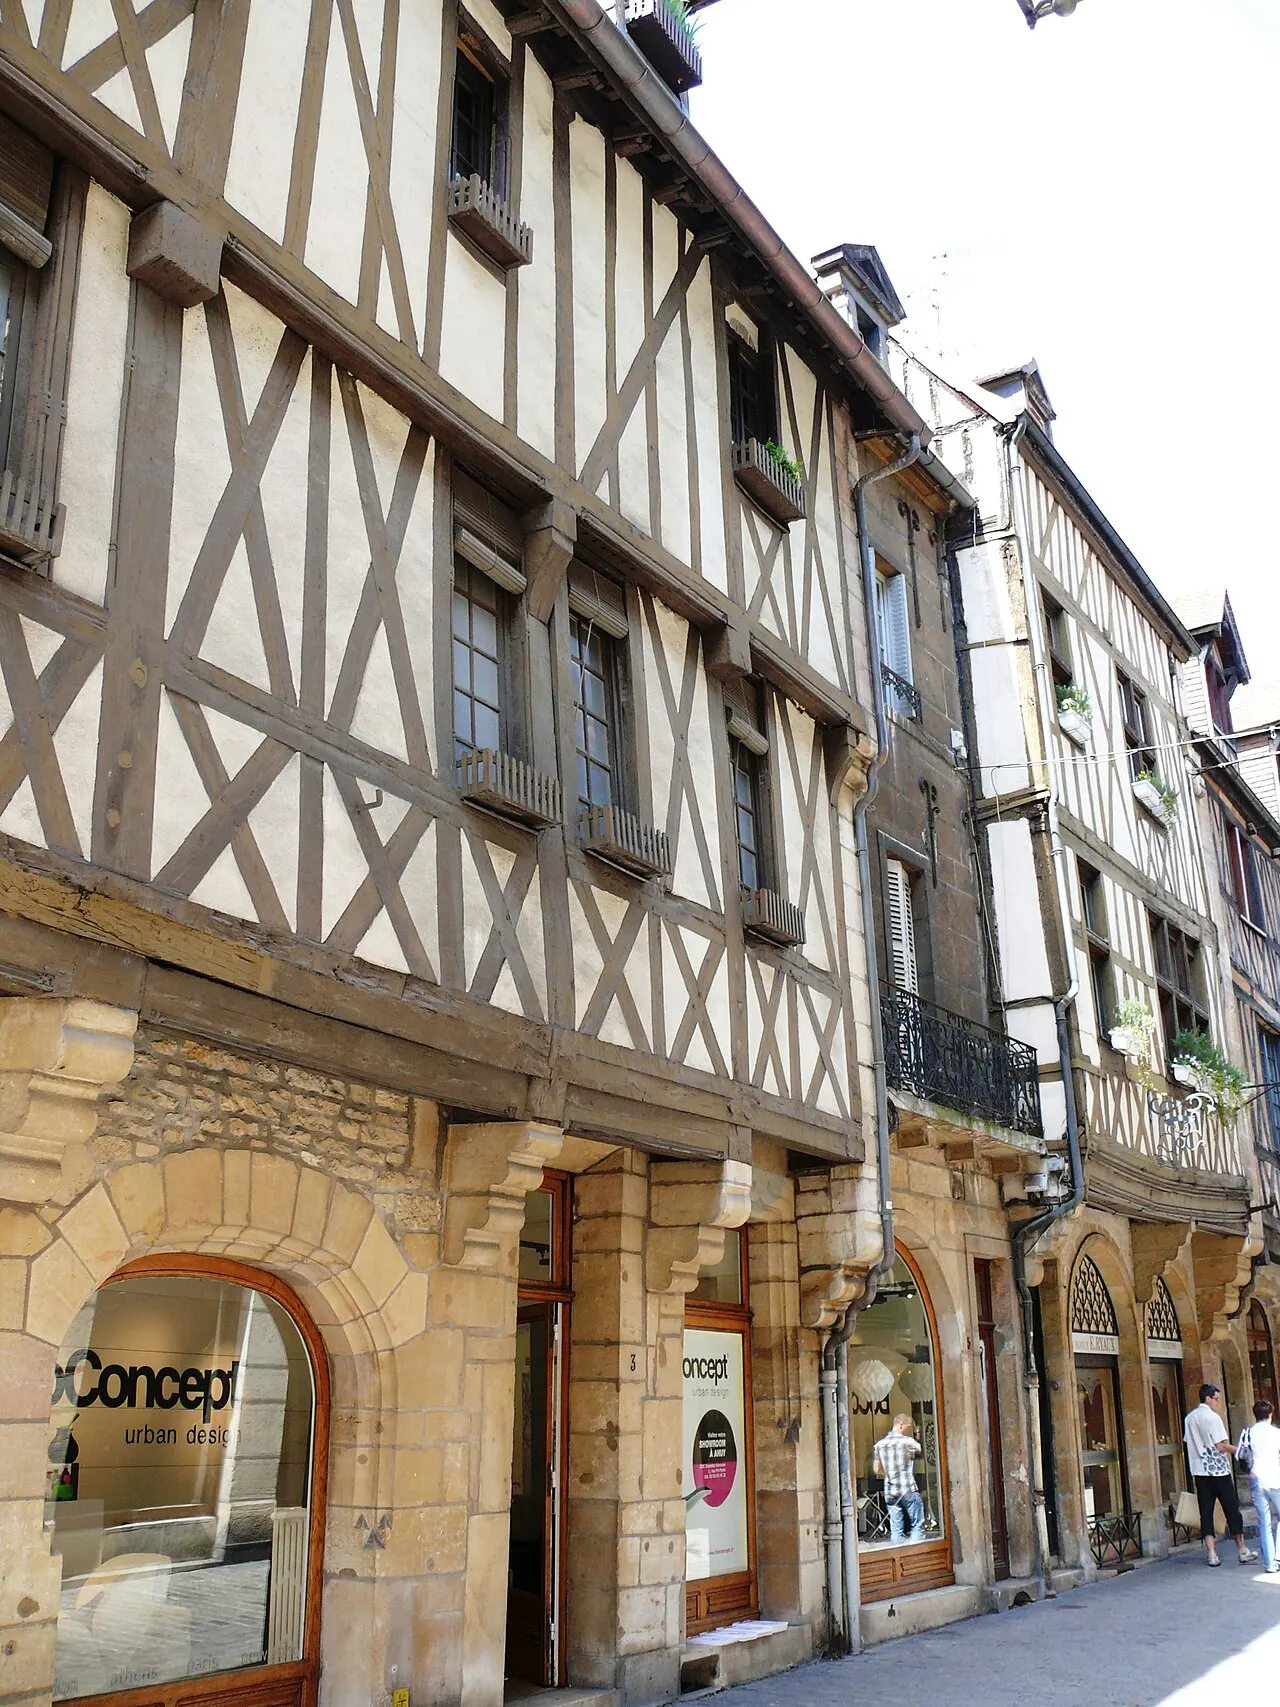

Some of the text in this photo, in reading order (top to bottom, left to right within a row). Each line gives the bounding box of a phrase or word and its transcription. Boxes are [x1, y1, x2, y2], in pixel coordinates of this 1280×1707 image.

[630, 1353, 637, 1372] 3
[124, 1423, 242, 1448] urban design
